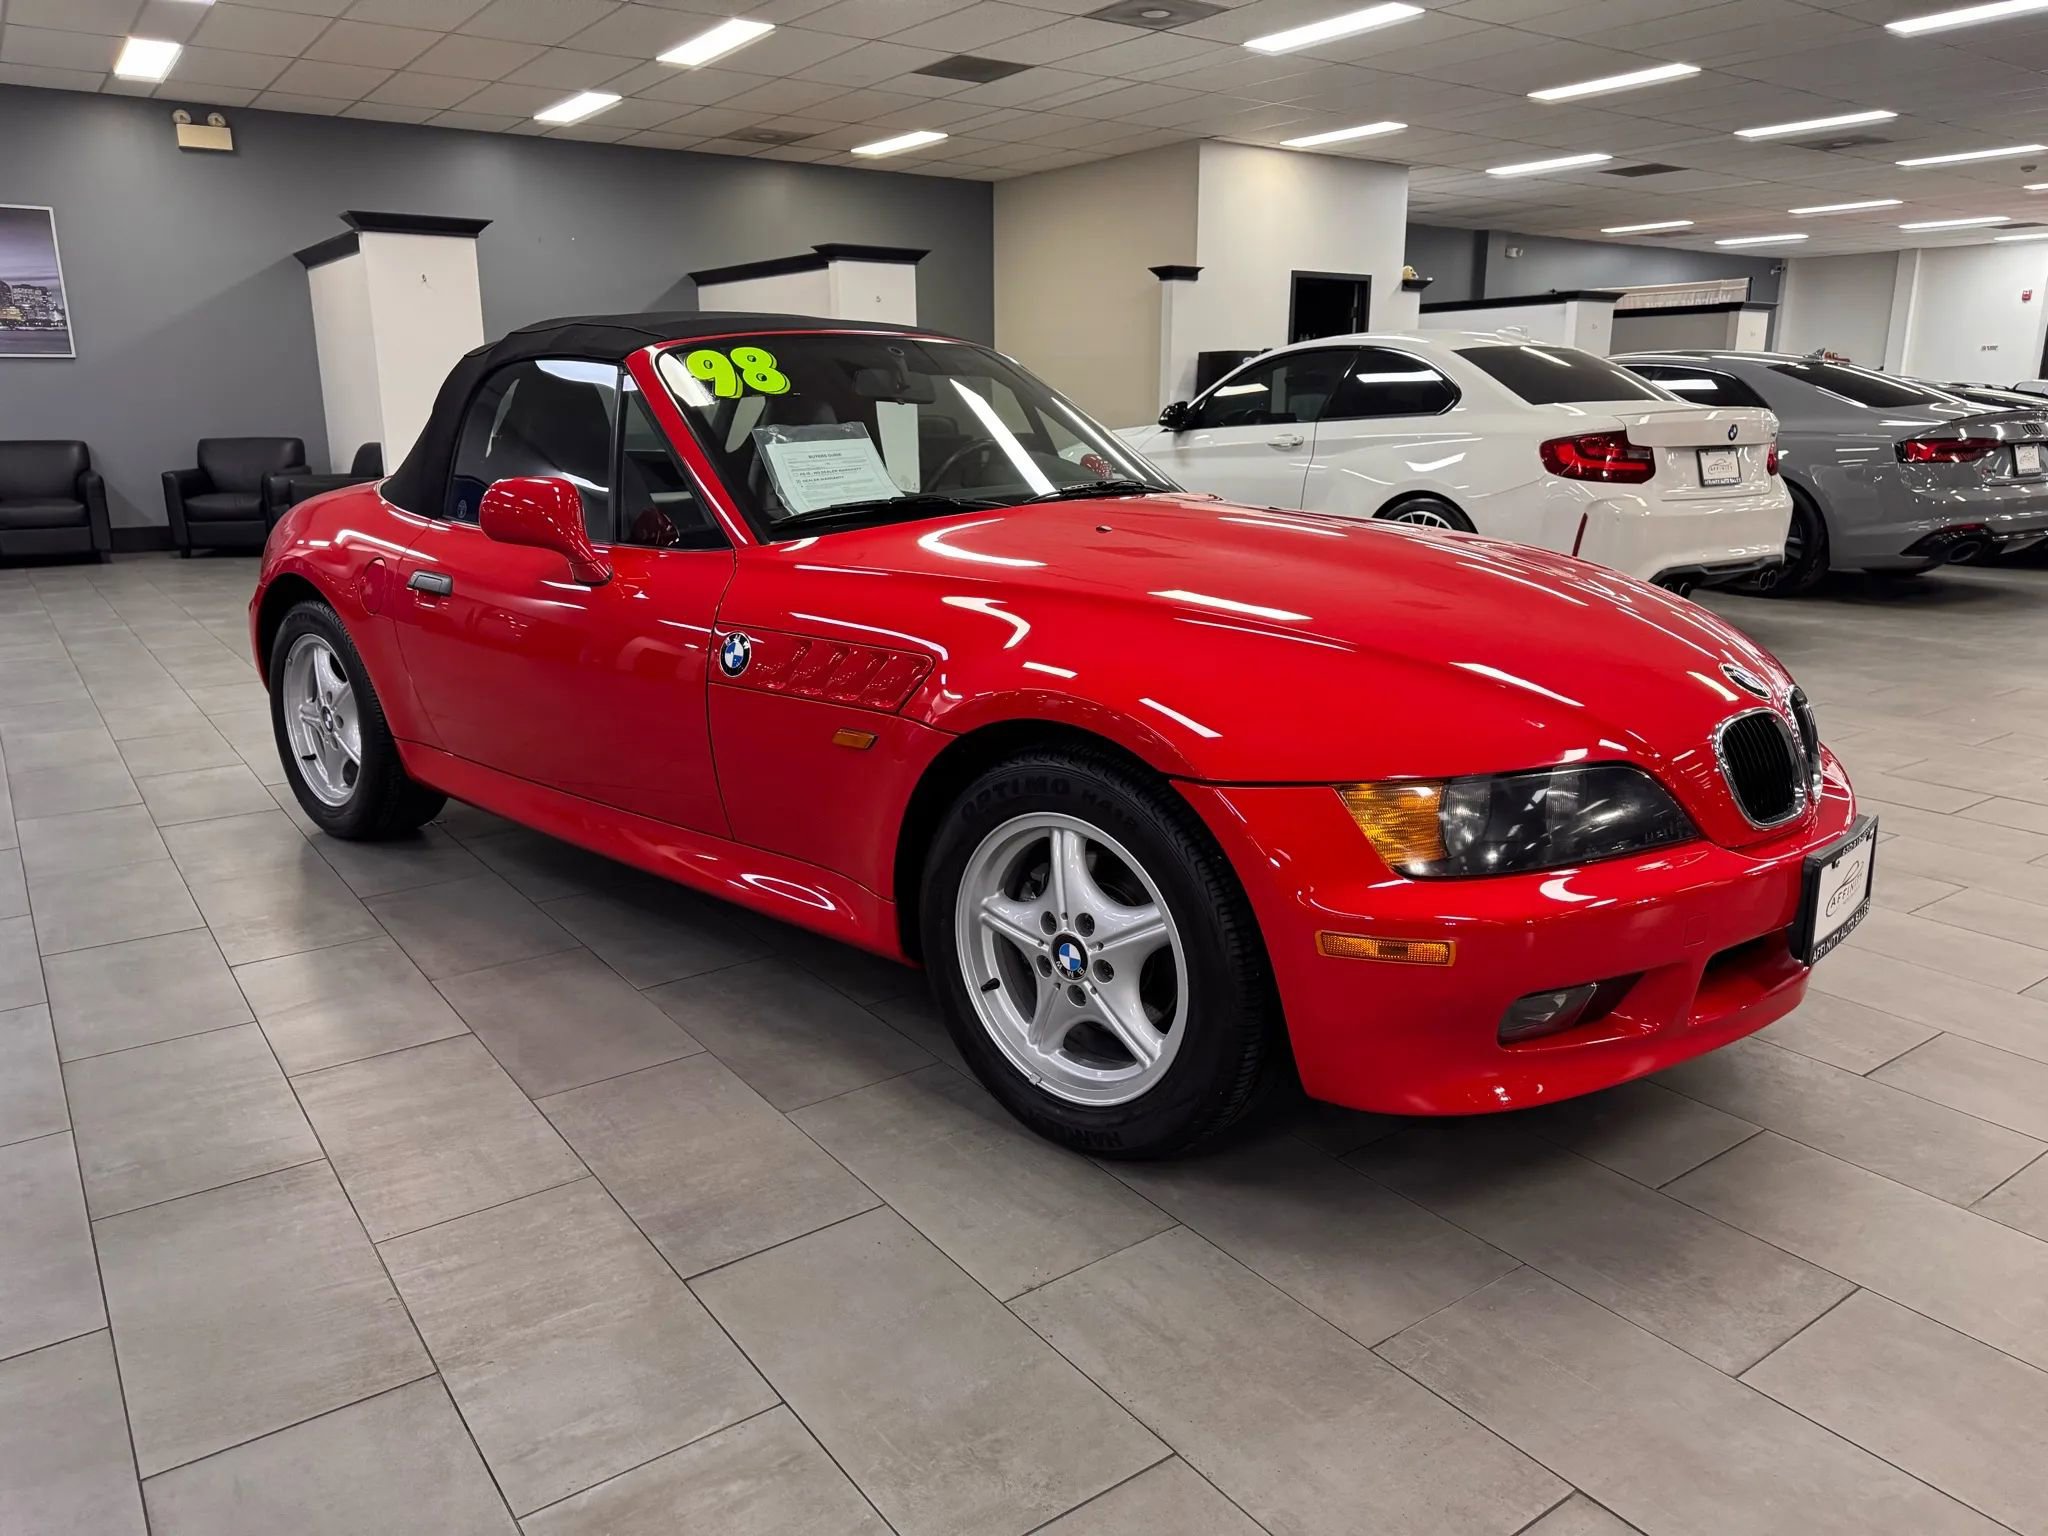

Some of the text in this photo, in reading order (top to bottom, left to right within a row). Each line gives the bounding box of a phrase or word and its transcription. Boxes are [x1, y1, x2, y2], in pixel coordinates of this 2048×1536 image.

[685, 346, 792, 399] 98
[960, 775, 1071, 822] OPTIMO
[1830, 872, 1863, 907] AFFINITY
[1811, 927, 1842, 963] AFFINITY
